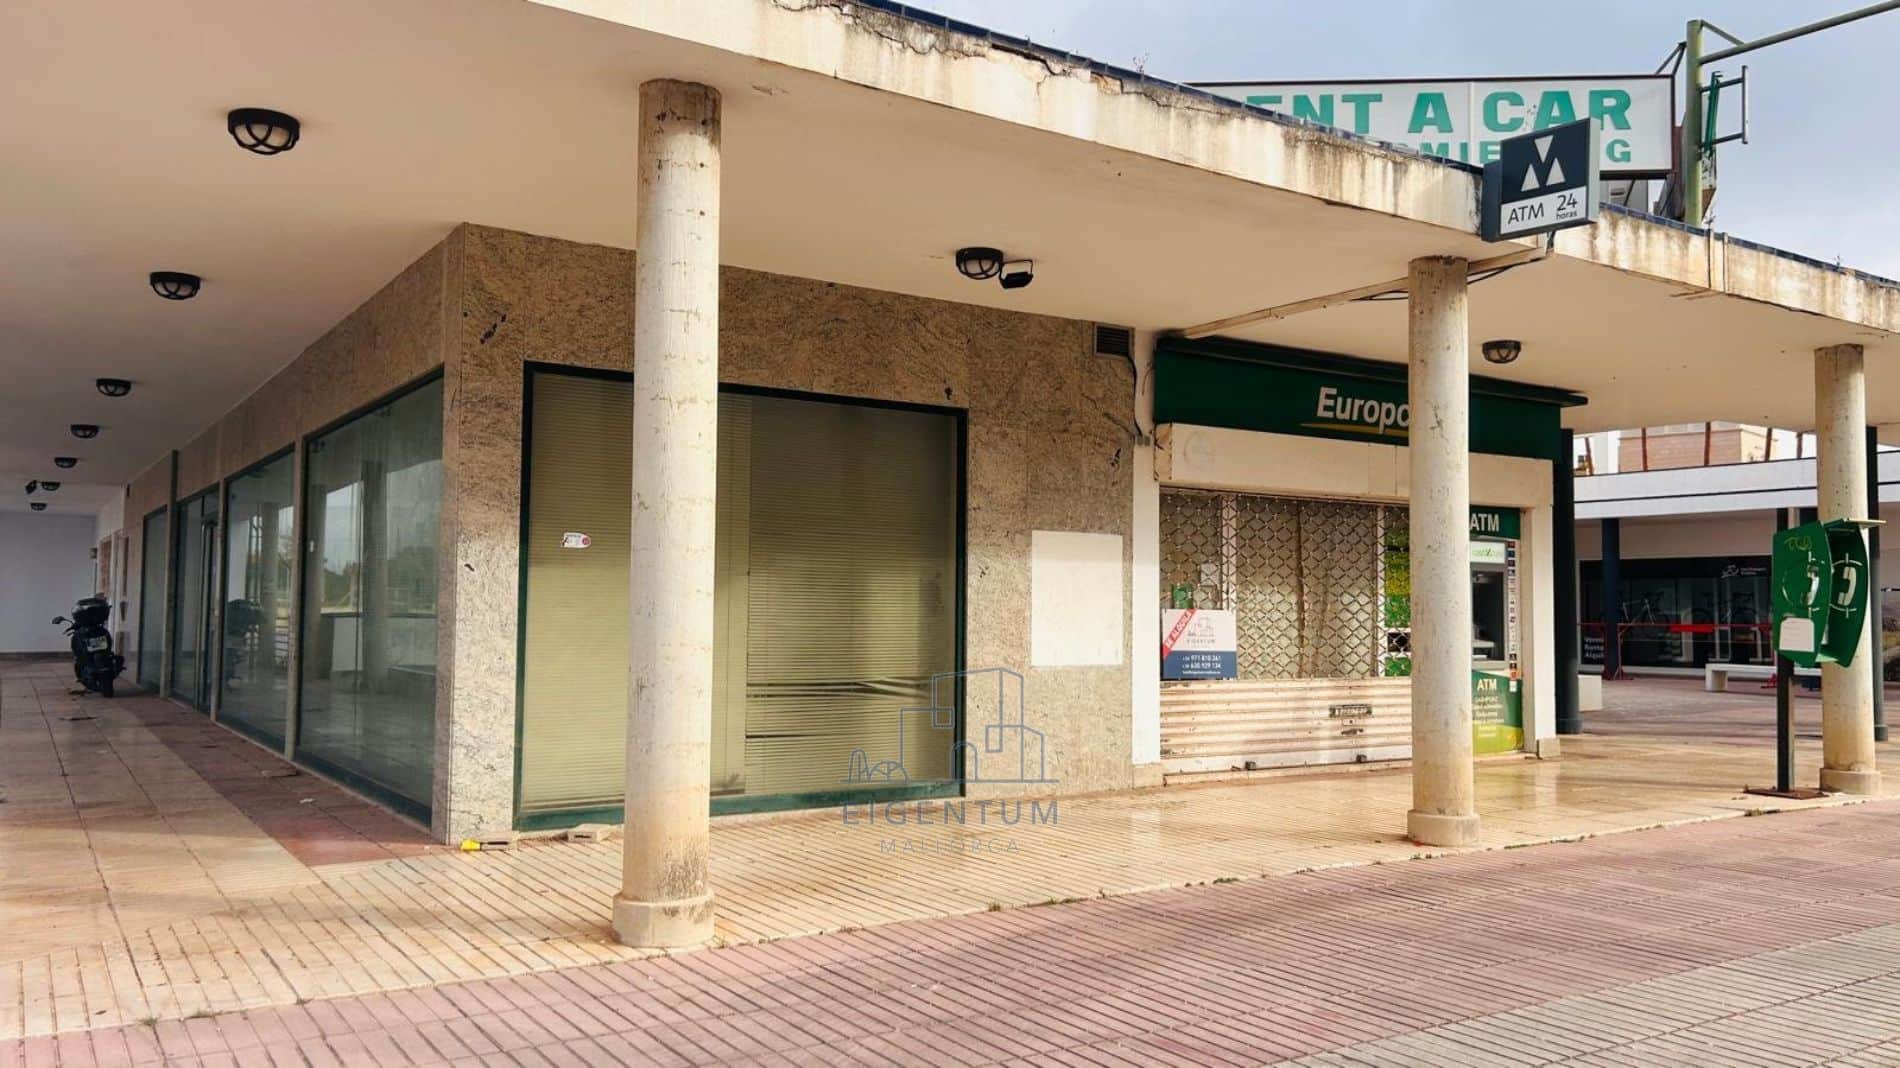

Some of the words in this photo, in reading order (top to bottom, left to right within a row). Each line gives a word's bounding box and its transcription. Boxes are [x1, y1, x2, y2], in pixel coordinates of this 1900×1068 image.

[1408, 92, 1453, 133] A
[1483, 90, 1632, 132] CAR
[1508, 202, 1545, 224] ATM
[1557, 193, 1578, 211] 24
[1556, 210, 1577, 220] horas
[1470, 513, 1500, 532] ATM
[1476, 678, 1497, 691] ATM
